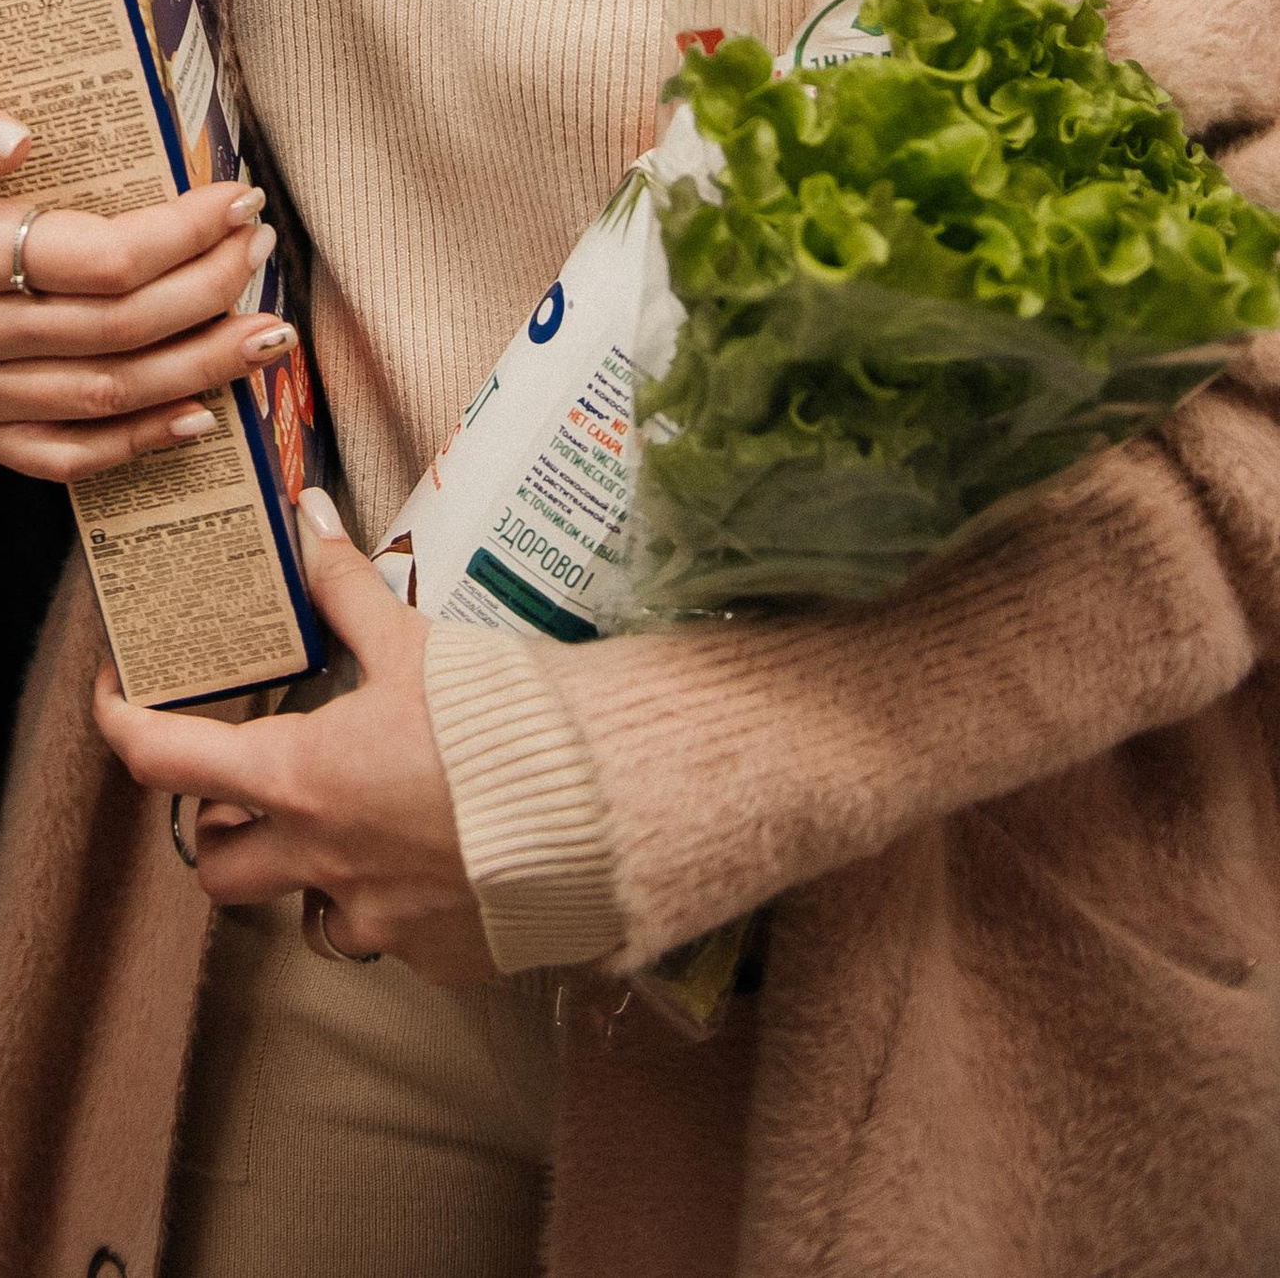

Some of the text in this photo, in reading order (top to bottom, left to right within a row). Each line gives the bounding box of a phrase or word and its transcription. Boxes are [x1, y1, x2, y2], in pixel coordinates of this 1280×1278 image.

[558, 424, 589, 453] Только
[567, 407, 623, 456] НЕТ САХАРА
[531, 465, 543, 477] на
[542, 474, 605, 524] растительной
[538, 453, 609, 511] Наш кокосовый
[549, 434, 627, 500] ТРОПИЧЕСКОГО
[516, 483, 582, 540] ИСТОЧНИКОМ
[533, 481, 573, 514] является
[493, 506, 595, 595] ЗДОРОВО!
